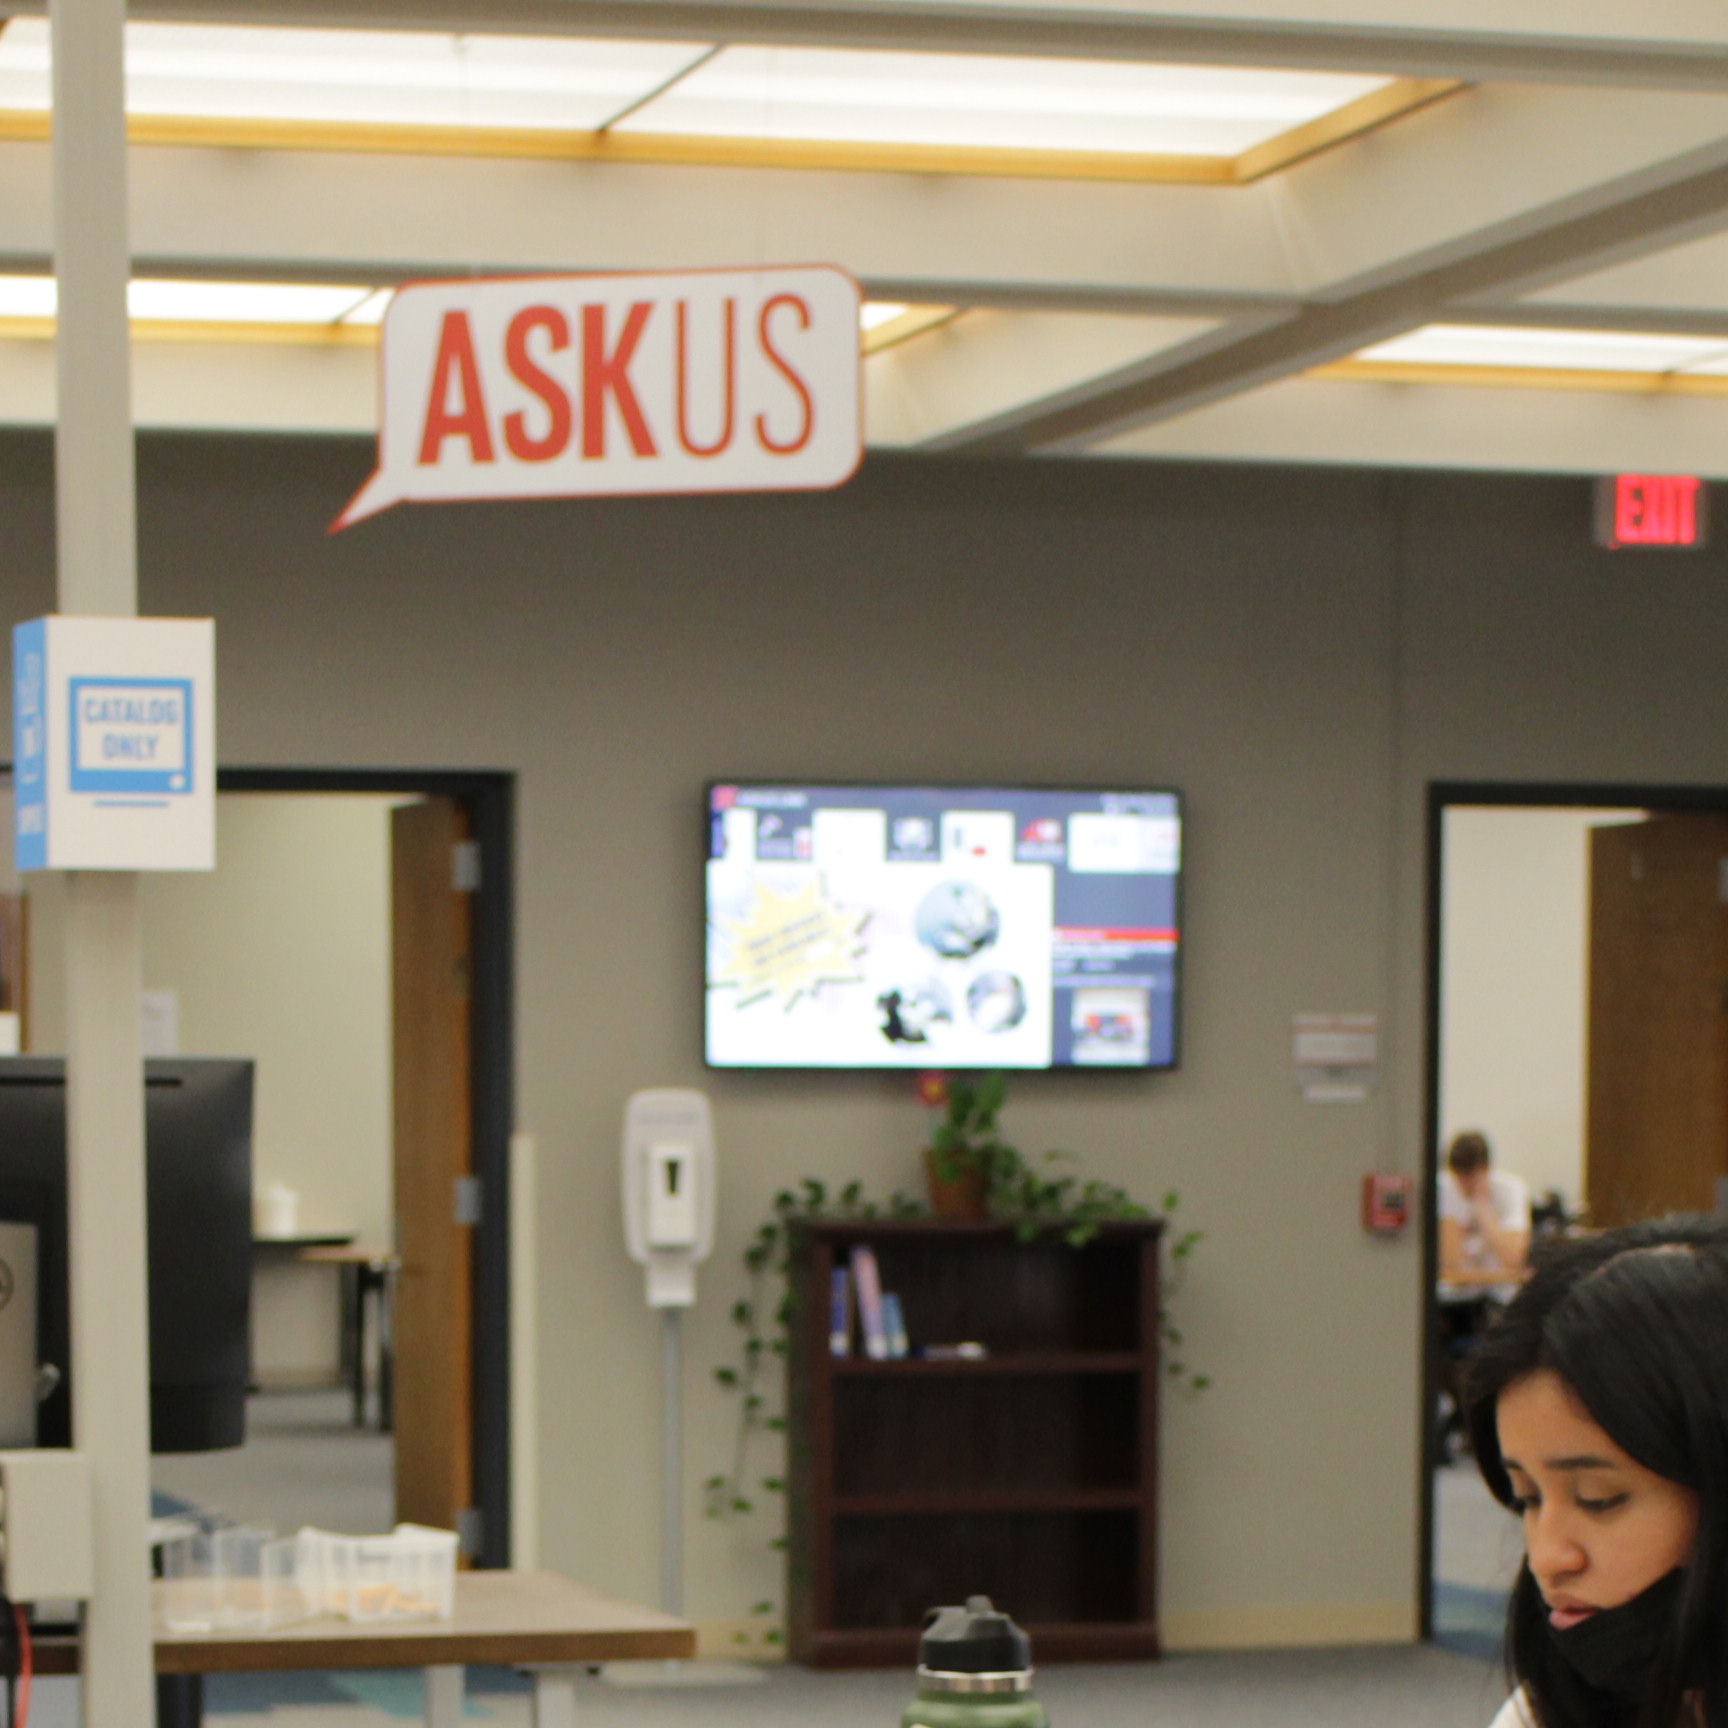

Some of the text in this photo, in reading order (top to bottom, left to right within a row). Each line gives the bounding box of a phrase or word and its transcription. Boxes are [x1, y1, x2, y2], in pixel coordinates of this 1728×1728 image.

[1615, 473, 1701, 546] EXIT
[84, 696, 179, 724] CATALOG
[101, 733, 160, 760] ONLY
